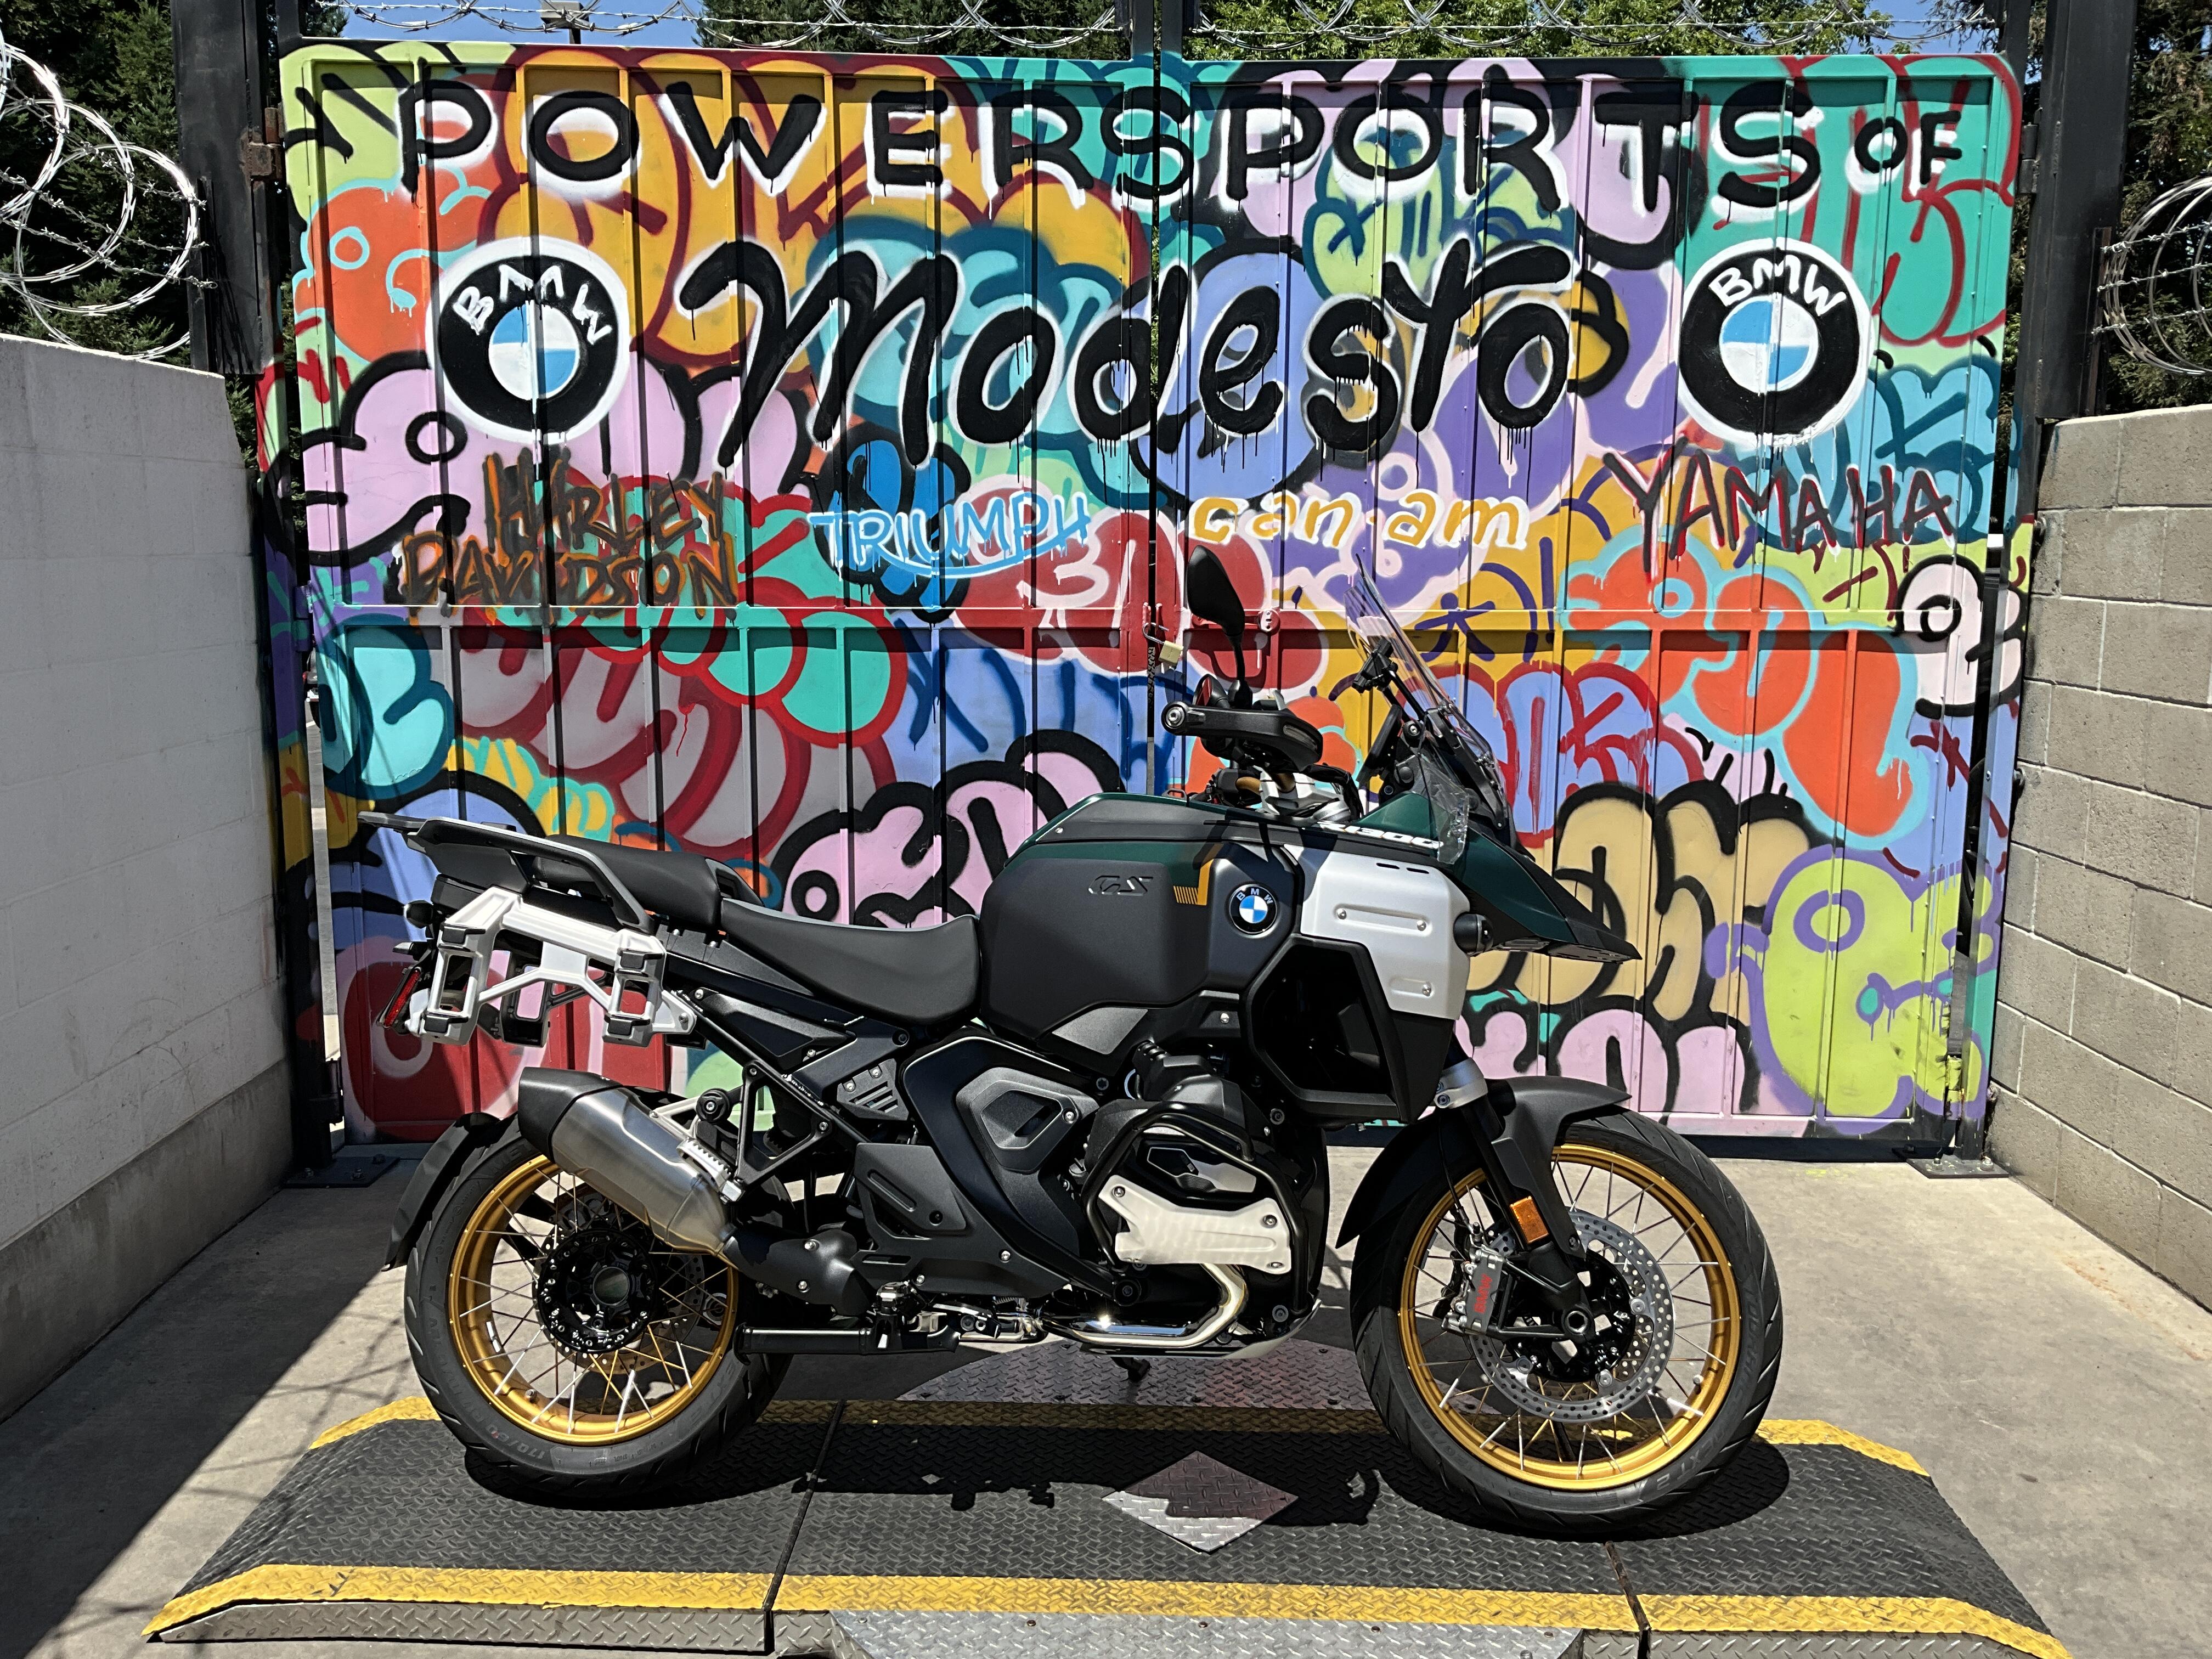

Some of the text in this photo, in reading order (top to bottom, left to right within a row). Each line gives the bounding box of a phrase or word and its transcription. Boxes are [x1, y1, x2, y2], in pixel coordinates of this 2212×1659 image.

[401, 66, 1963, 212] POWERSPORTS OF
[453, 264, 612, 345] BMW
[1711, 258, 1847, 317] BMW
[808, 490, 1092, 579] TRIUMPH
[1603, 437, 1954, 580] YAMAHA
[1088, 876, 1153, 896] GS
[1235, 887, 1274, 905] BMW
[1474, 1273, 1492, 1314] BMW
